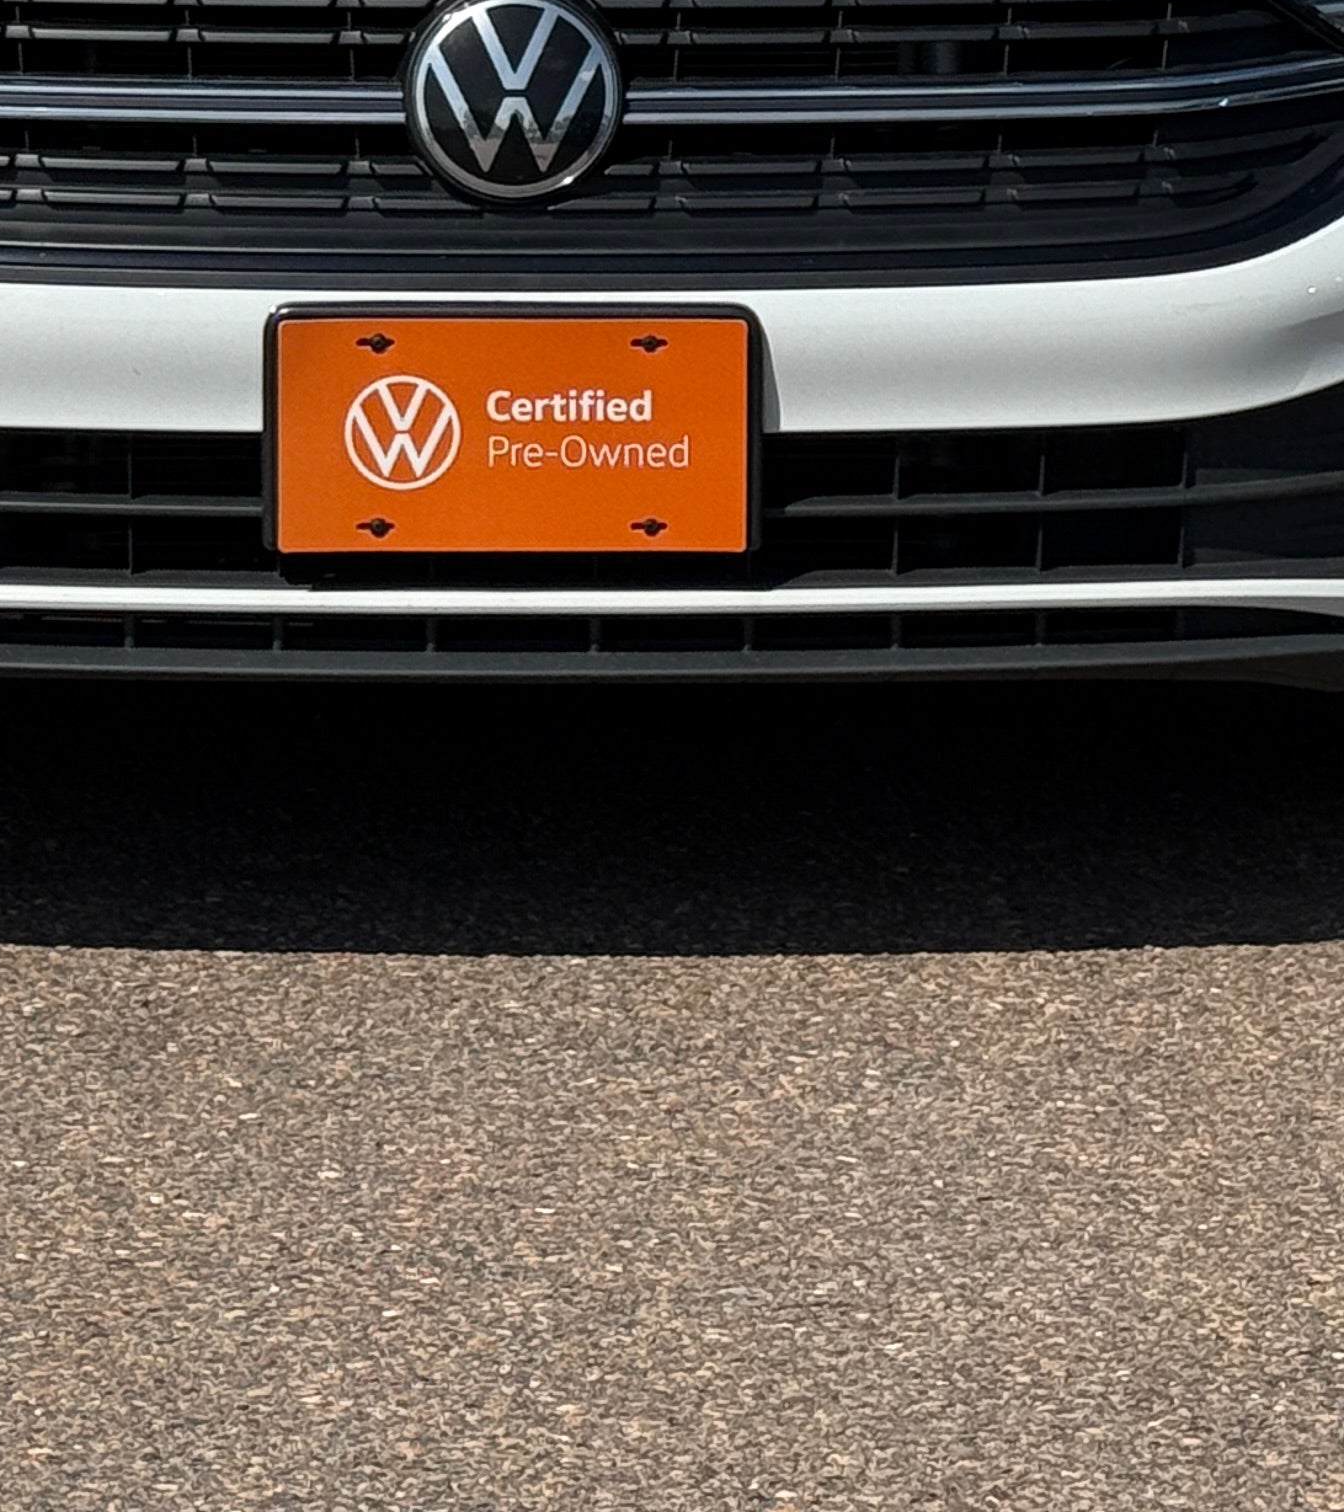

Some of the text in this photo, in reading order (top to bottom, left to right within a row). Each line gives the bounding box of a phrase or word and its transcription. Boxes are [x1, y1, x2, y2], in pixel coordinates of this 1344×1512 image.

[420, 0, 606, 175] VW
[349, 379, 457, 482] VW
[485, 389, 653, 423] Certified
[487, 434, 690, 469] Pre-Owned
